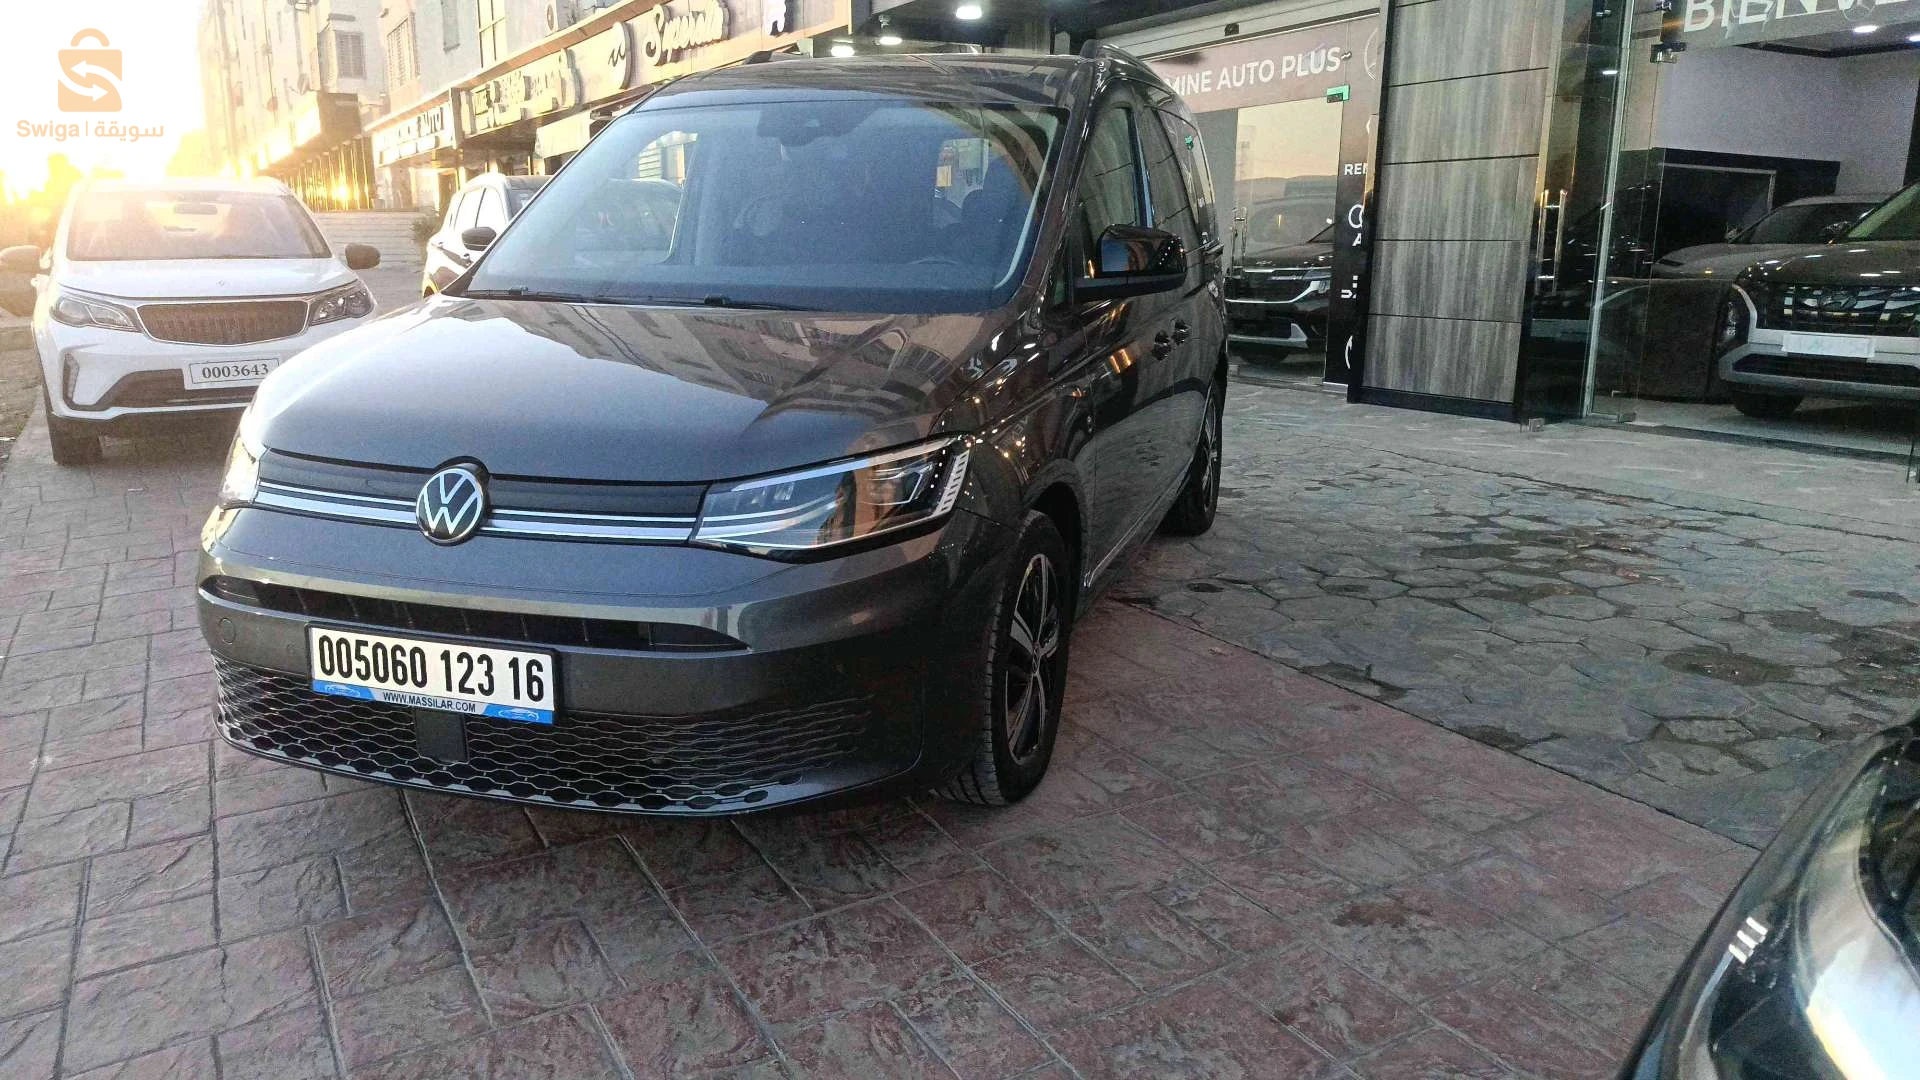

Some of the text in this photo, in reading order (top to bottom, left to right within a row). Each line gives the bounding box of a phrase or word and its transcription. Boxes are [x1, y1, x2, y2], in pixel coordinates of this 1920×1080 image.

[1216, 59, 1274, 90] AUTO
[1281, 46, 1341, 80] PLUS
[202, 363, 269, 379] 0003643
[318, 634, 545, 702] 005060 123 16
[383, 692, 476, 713] WWW.MASSILAR.COM
